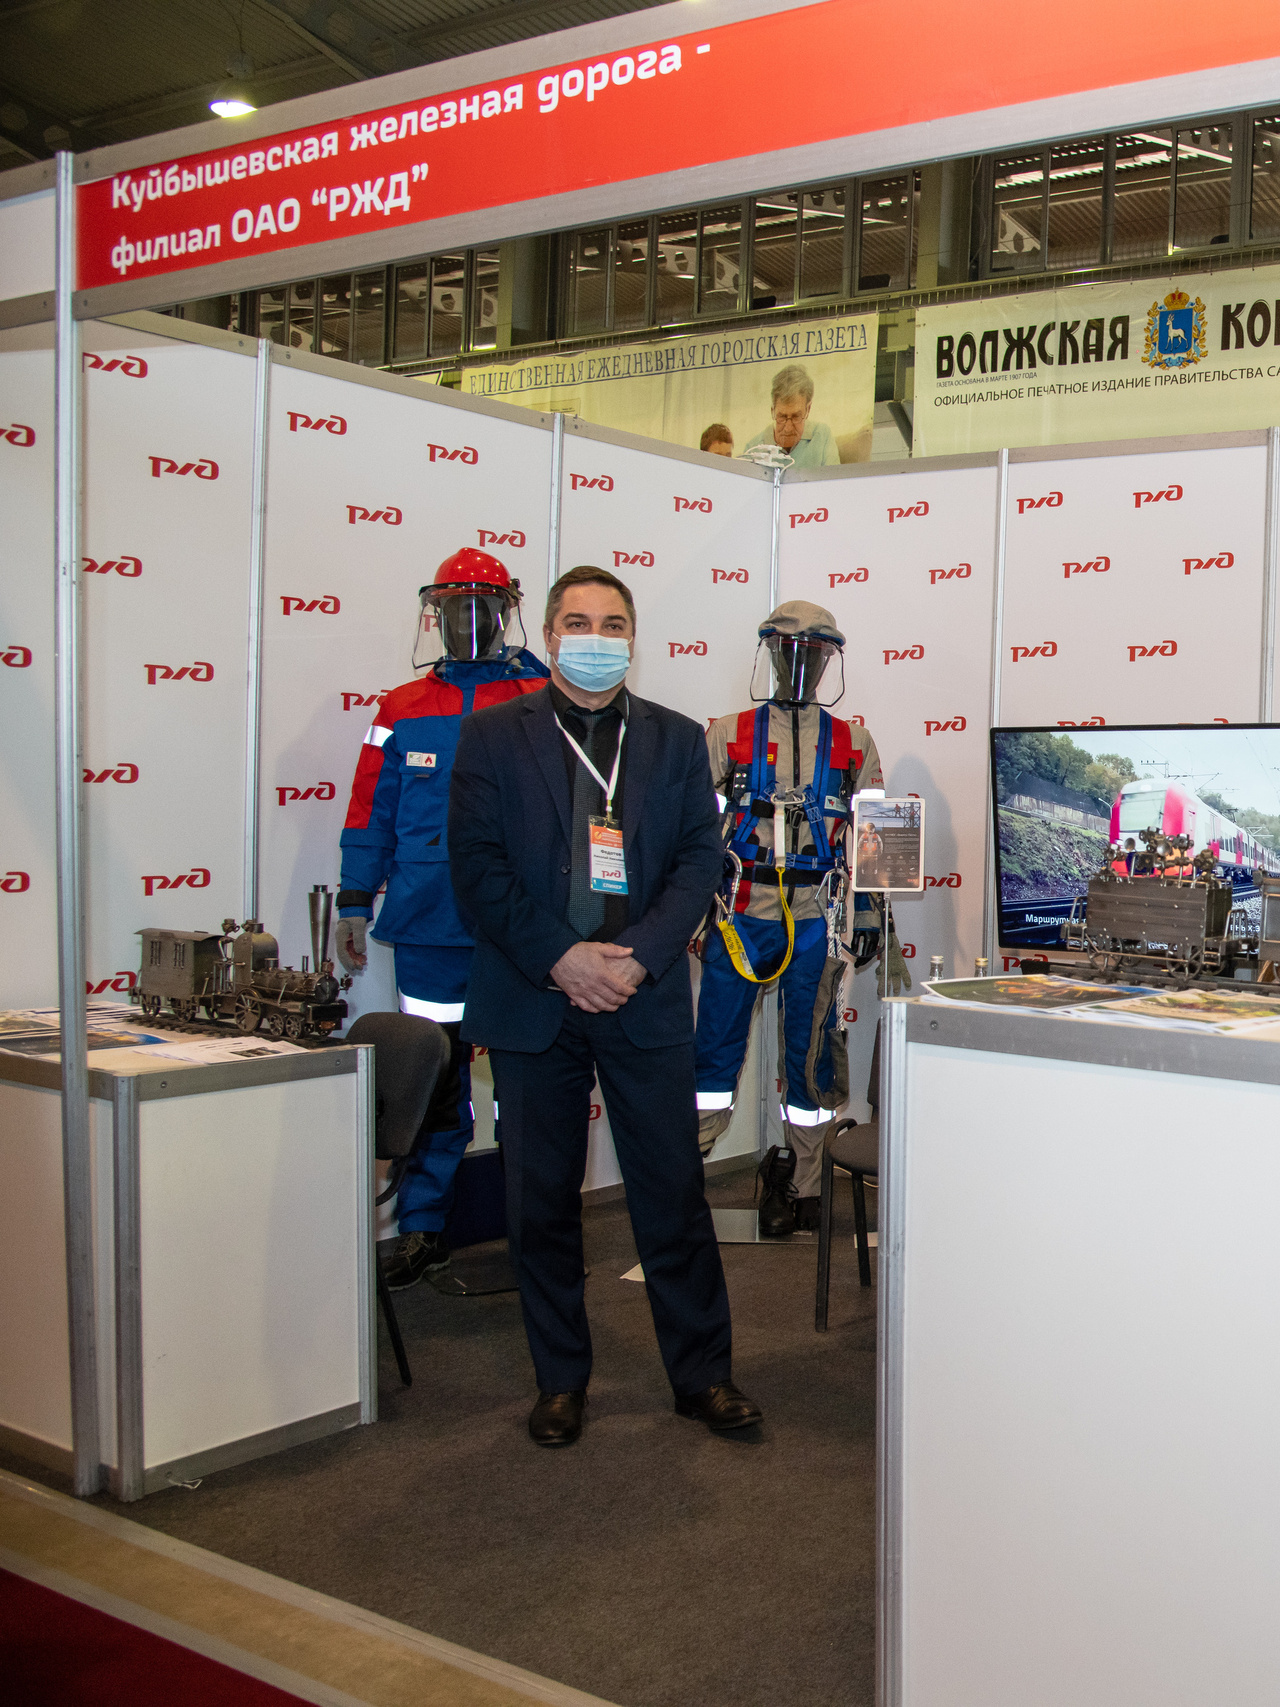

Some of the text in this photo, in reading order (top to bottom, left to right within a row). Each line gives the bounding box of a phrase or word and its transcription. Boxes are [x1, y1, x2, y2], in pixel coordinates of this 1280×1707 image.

[111, 129, 338, 209] Куйбышевская
[349, 84, 523, 150] железная
[537, 42, 683, 113] дорога
[111, 223, 221, 275] филиал
[231, 203, 301, 245] ОАО
[470, 323, 868, 396] ЕДИНСТВЕННАЯ ЕЖЕДНЕВНАЯ ГОРОДСКАЯ ГАЗЕТА
[936, 314, 1129, 379] ВОЛЖСКАЯ
[934, 388, 1024, 407] ОФИЦИАЛЬНОЕ
[1027, 382, 1089, 398] ПЕЧАТНОЕ
[1092, 376, 1151, 392] ИЗДАНИЕ
[1154, 367, 1264, 387] ПРАВИТЕЛЬСТВА
